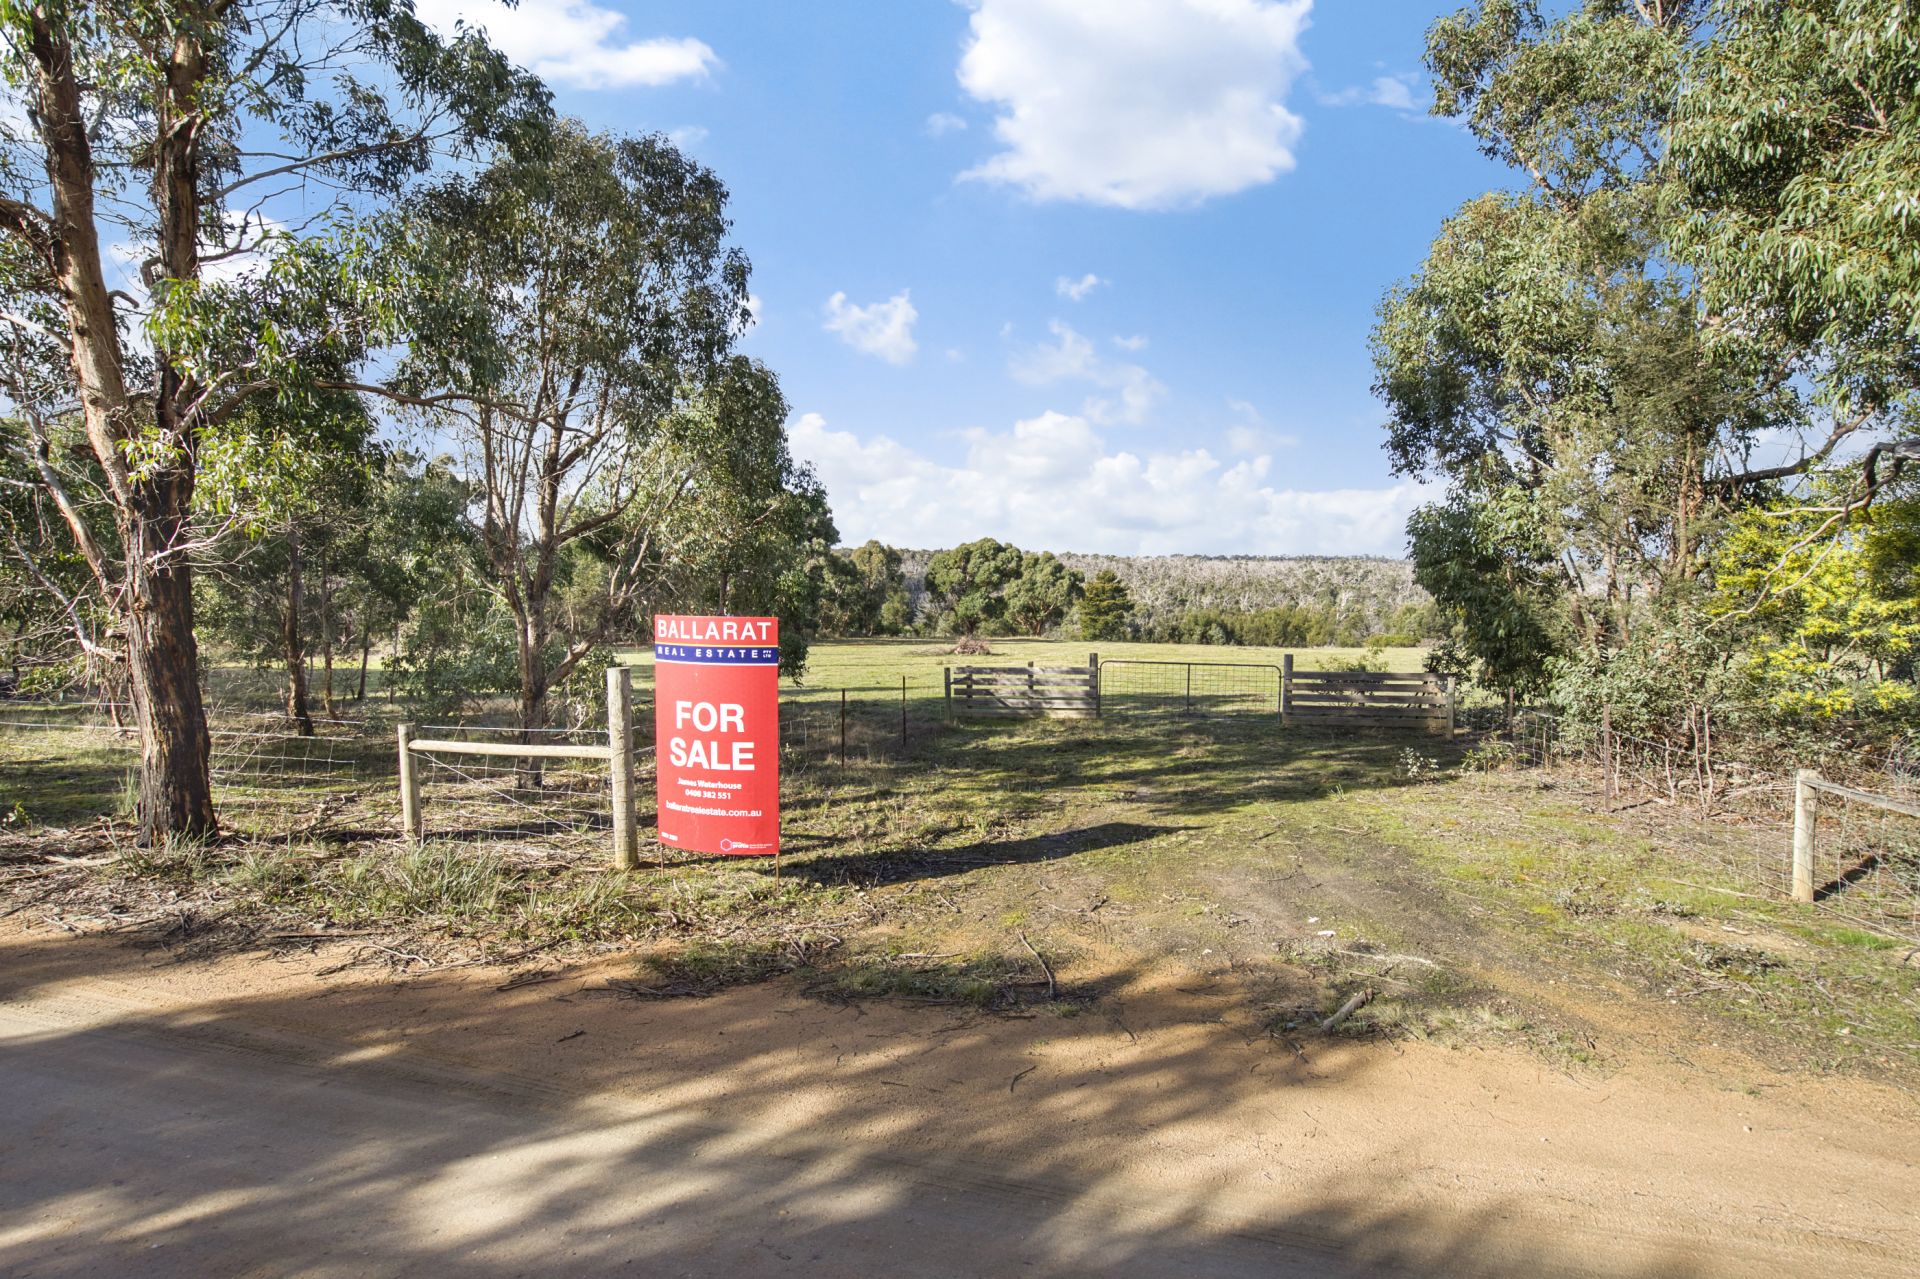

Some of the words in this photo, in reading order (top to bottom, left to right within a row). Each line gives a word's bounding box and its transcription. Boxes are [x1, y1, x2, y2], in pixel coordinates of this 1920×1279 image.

[658, 619, 772, 640] BALLARAT
[658, 646, 685, 656] REAL
[696, 649, 758, 658] ESTATE
[676, 700, 744, 732] FOR
[670, 737, 755, 770] SALE
[678, 778, 697, 787] James
[697, 780, 742, 789] Waterhouse
[666, 800, 761, 816] ballaratrealestate.com.au
